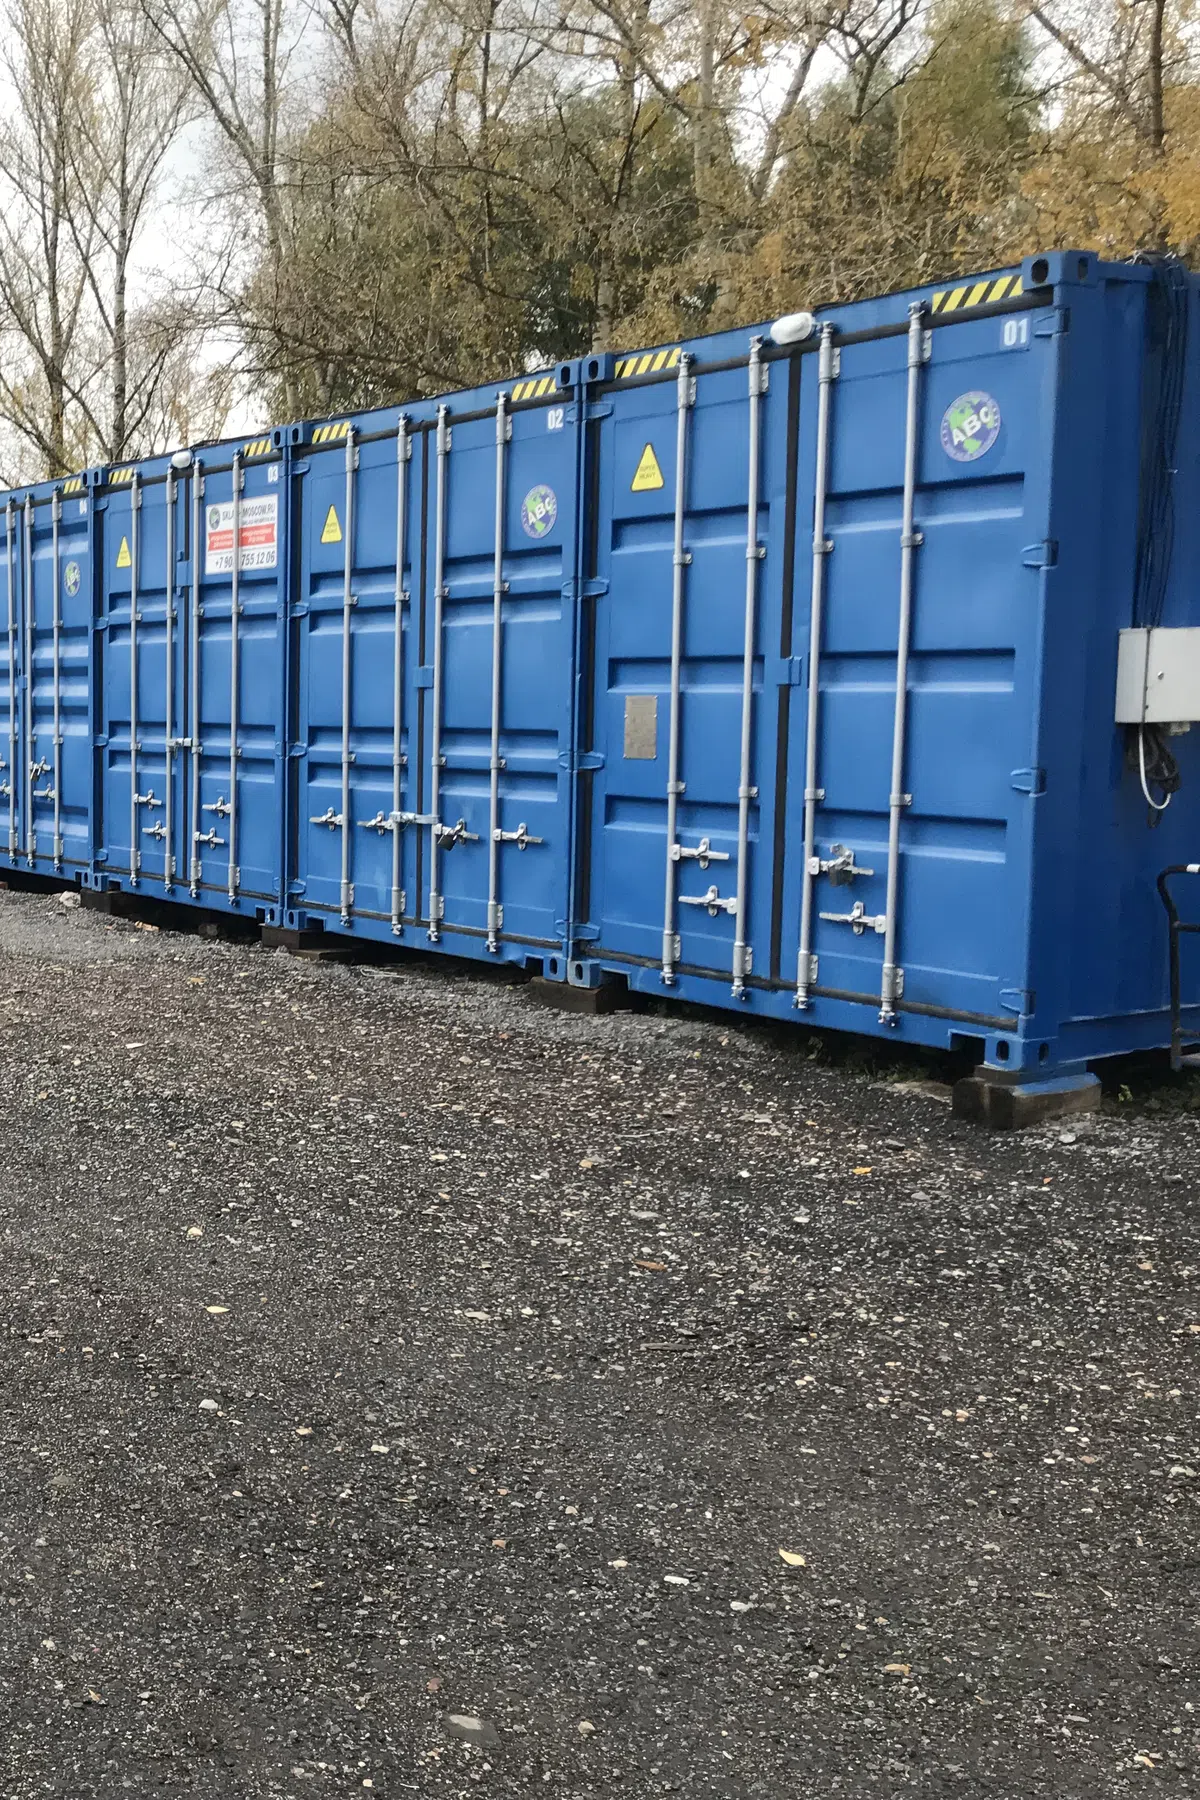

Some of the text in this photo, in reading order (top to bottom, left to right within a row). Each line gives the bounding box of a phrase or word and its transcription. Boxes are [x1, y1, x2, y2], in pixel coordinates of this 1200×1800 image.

[1004, 318, 1028, 346] 01
[548, 409, 564, 430] 02
[953, 406, 990, 446] ABC
[267, 465, 279, 483] 03
[528, 497, 551, 526] ABC
[215, 556, 224, 568] +7
[242, 552, 255, 566] 755
[256, 551, 265, 565] 12
[266, 550, 275, 564] 06
